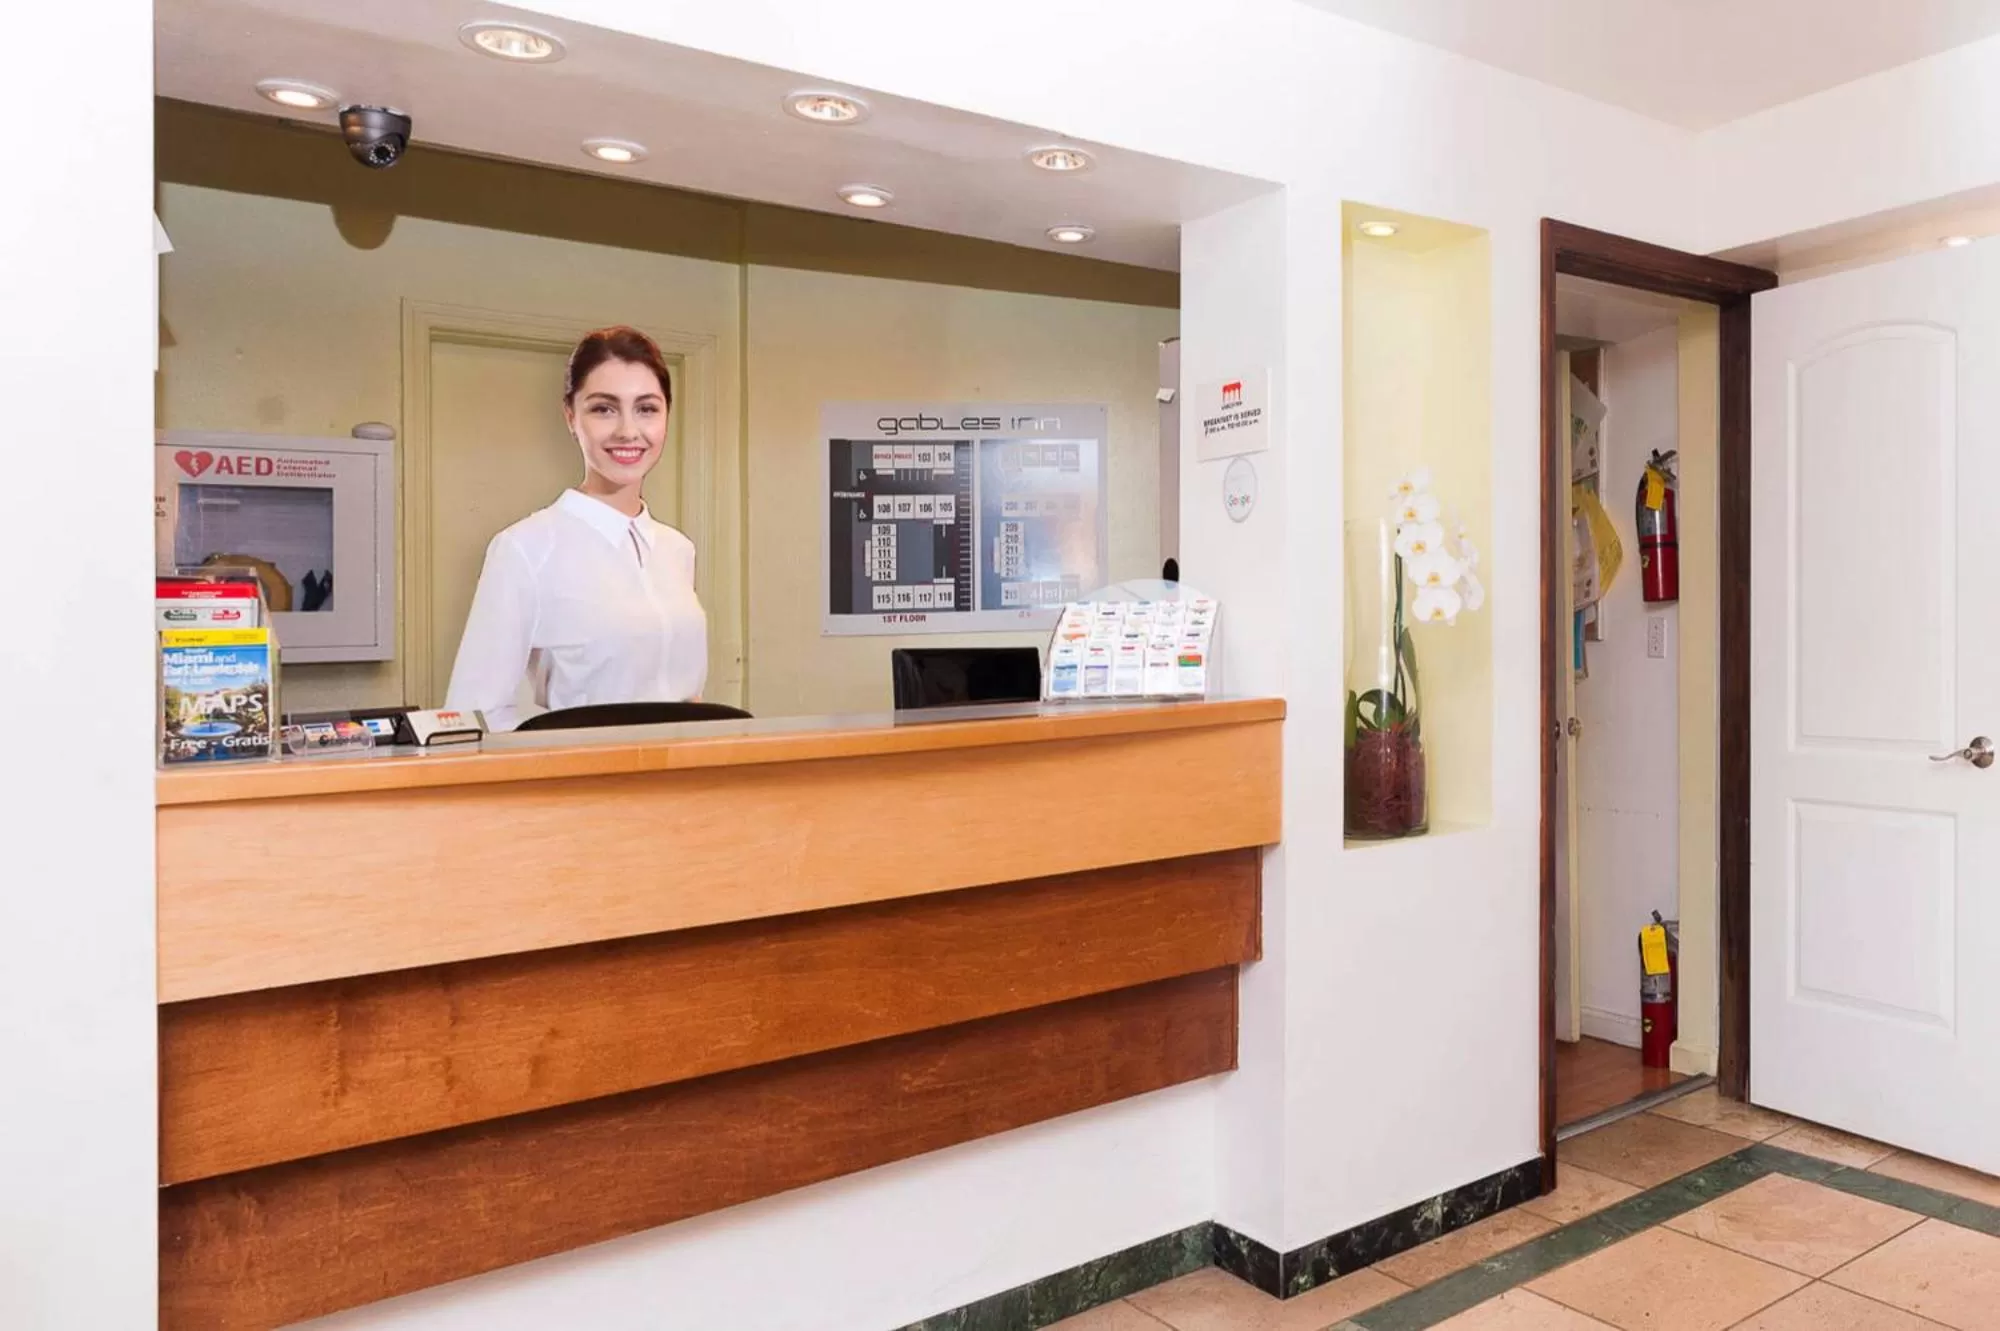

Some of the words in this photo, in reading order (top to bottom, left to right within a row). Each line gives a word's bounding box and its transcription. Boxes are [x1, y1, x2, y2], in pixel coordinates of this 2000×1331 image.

[917, 452, 932, 463] 103
[214, 455, 274, 477] AED
[897, 502, 912, 513] 107
[877, 525, 891, 535] 109
[877, 537, 892, 547] 110
[877, 548, 891, 558] 111
[877, 560, 892, 570] 112
[877, 570, 892, 580] 114
[877, 594, 892, 604] 115
[897, 593, 912, 603] 116
[919, 592, 932, 603] 117
[881, 614, 897, 623] 1ST
[899, 613, 927, 623] FLOOR
[163, 651, 214, 665] Miami
[179, 692, 264, 715] MAPS
[170, 738, 208, 751] Free
[221, 732, 271, 749] Gratis
